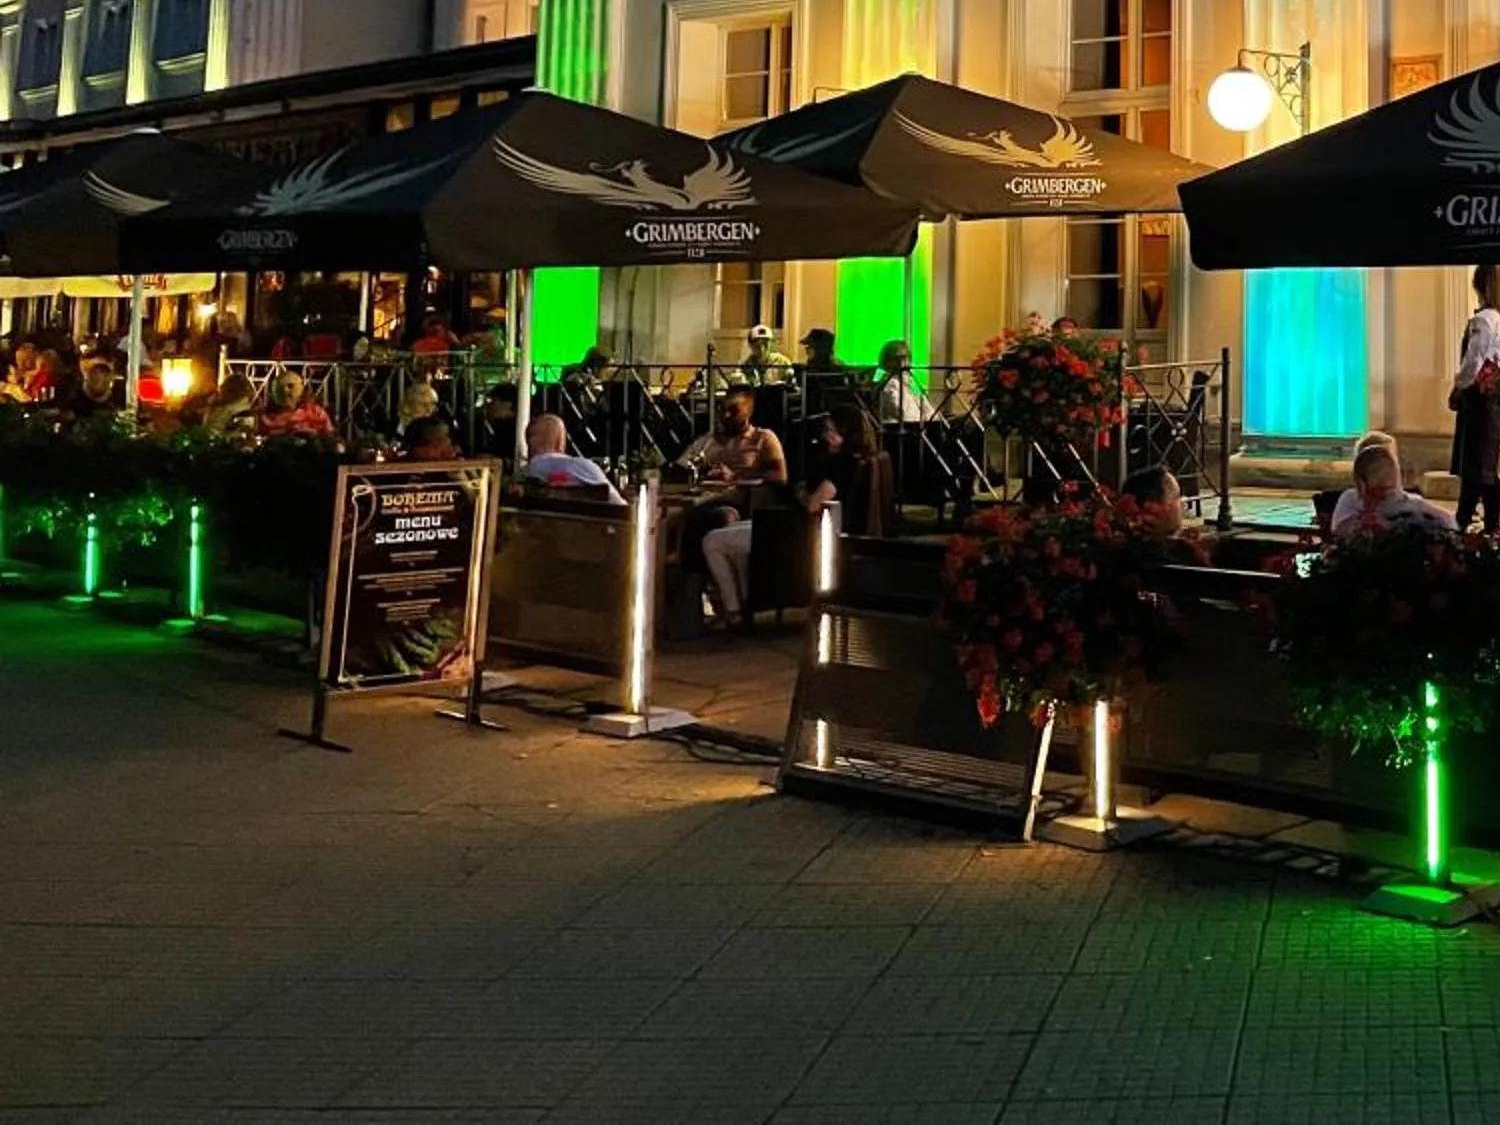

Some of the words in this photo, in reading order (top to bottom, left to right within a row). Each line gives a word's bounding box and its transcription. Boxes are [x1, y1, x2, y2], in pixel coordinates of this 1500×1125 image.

[1011, 176, 1101, 194] GRIMBERGEN
[632, 222, 754, 243] GRIMBERGEN
[395, 516, 442, 530] menu
[374, 527, 459, 544] sezonowe
